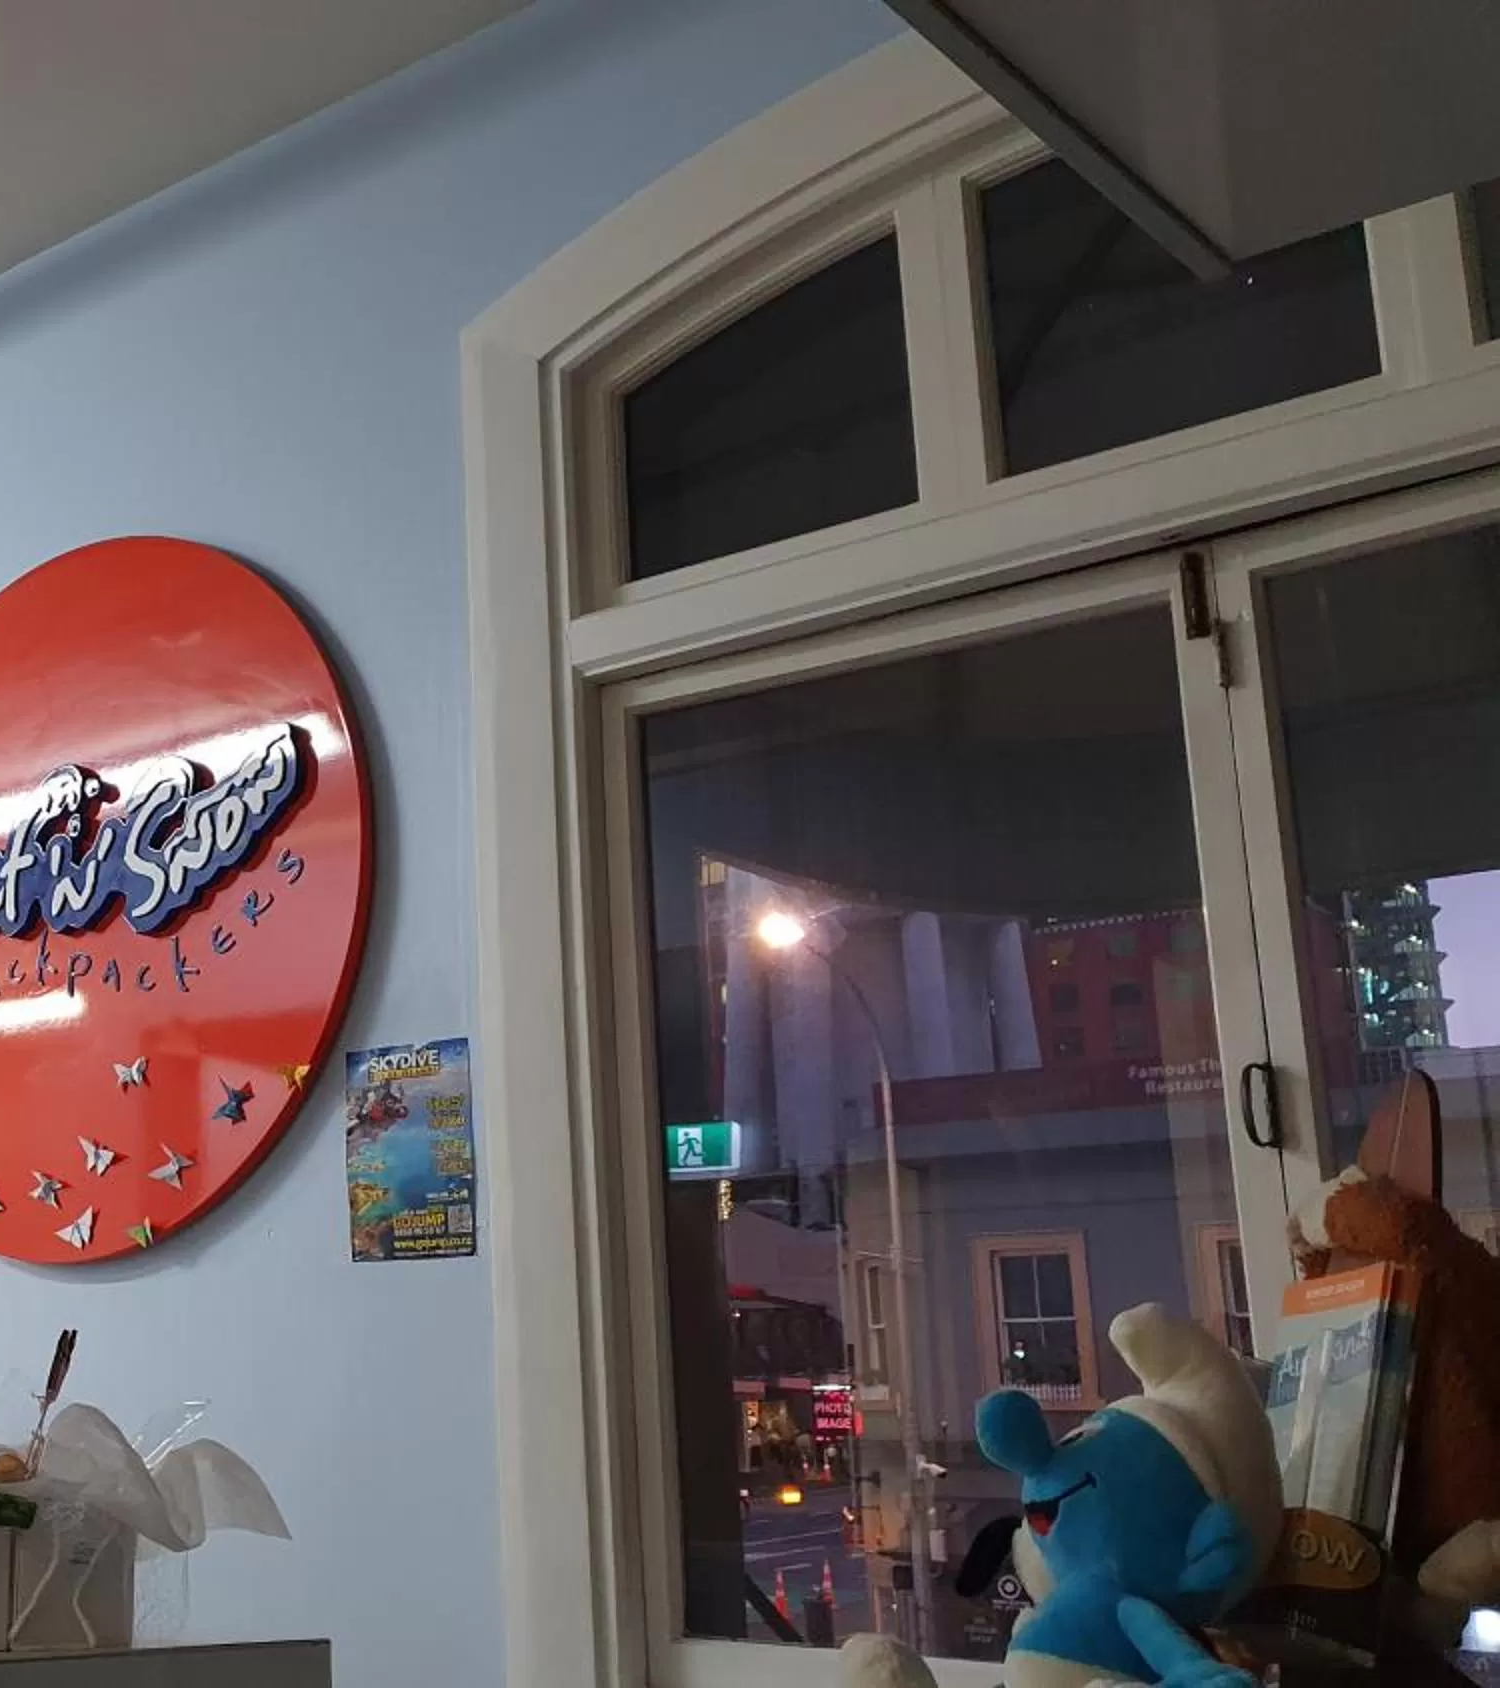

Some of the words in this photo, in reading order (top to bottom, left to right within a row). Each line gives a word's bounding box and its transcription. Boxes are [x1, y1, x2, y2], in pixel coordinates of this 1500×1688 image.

[368, 1048, 440, 1073] SKYDIVE
[1128, 1063, 1196, 1079] Famous
[1200, 1058, 1221, 1073] Th
[1145, 1079, 1223, 1095] Restaura
[814, 1401, 853, 1415] PHOTO
[816, 1417, 852, 1430] IMAGE
